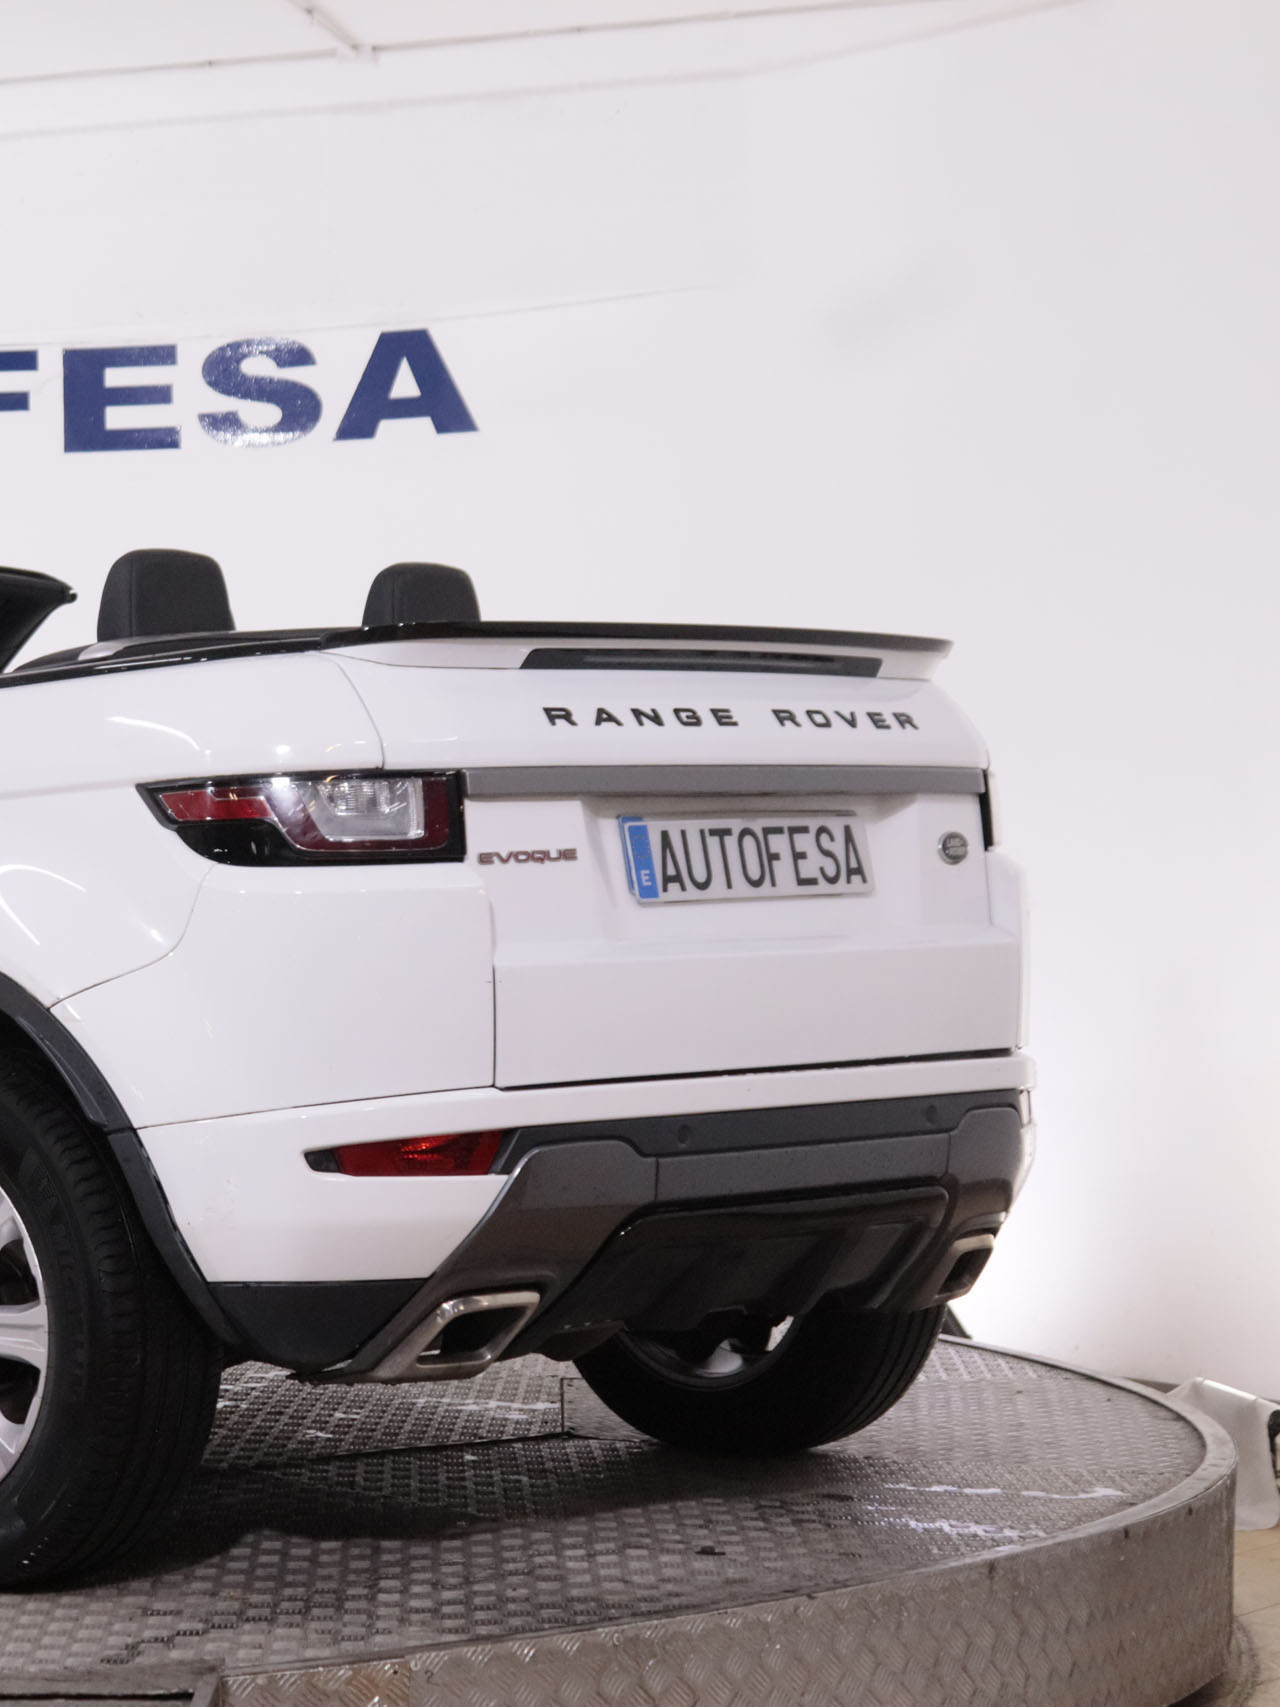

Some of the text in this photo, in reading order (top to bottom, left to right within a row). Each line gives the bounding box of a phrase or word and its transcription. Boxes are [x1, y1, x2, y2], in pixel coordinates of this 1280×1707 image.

[542, 706, 920, 731] RANGE ROVER
[477, 847, 578, 865] EVOQUE
[660, 823, 868, 893] AUTOFESA
[639, 869, 652, 886] E
